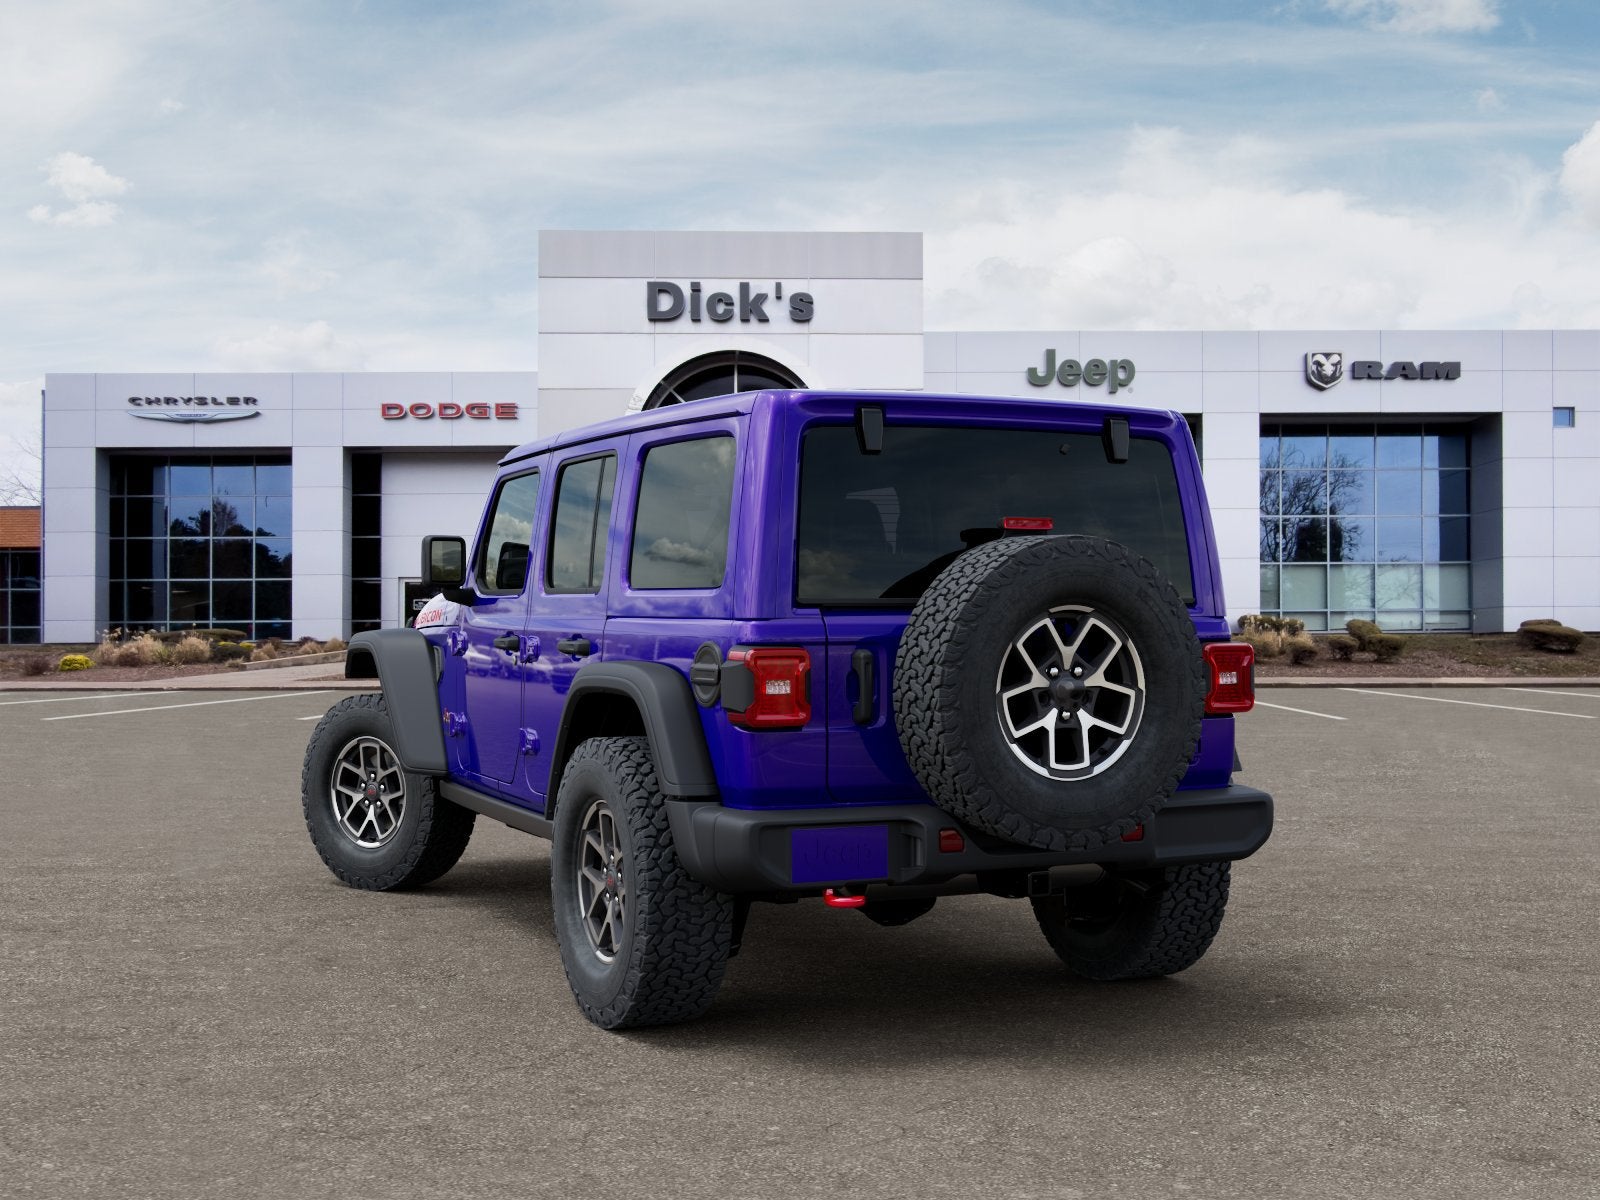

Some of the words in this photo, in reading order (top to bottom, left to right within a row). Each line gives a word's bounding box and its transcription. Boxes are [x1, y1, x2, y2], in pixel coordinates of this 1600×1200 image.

[646, 281, 814, 323] Dick's
[1027, 348, 1136, 394] Jeep
[1352, 360, 1461, 381] RAM
[127, 396, 259, 407] CHRYSLER
[381, 402, 519, 420] DODGE
